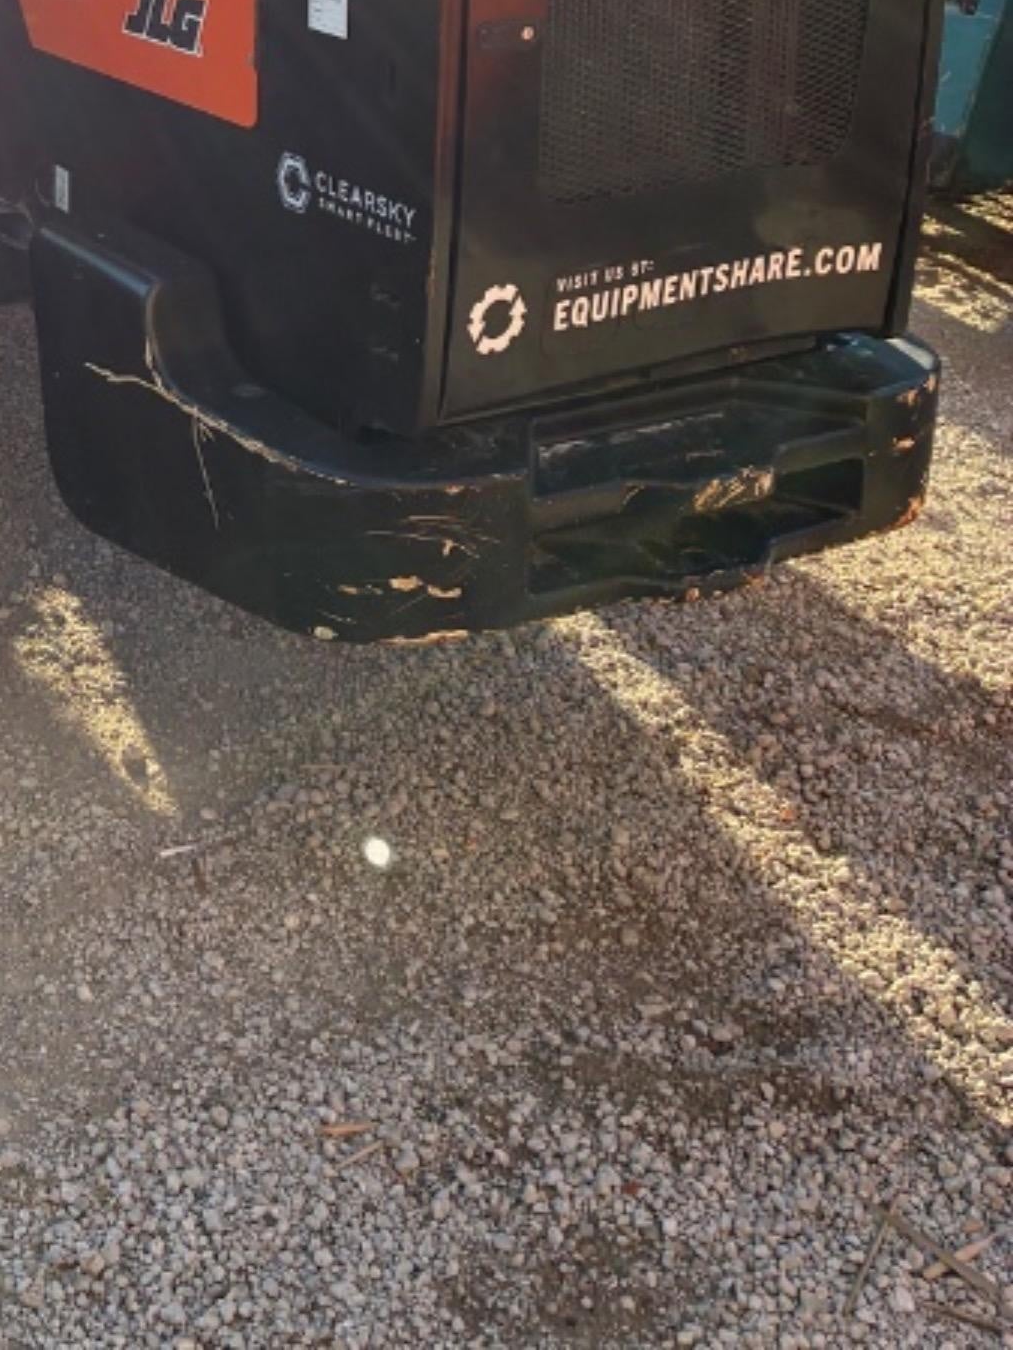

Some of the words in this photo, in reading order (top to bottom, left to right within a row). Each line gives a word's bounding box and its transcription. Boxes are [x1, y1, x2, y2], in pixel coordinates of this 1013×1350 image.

[315, 170, 417, 228] CLEARSKY
[553, 242, 883, 332] EQUIPMENTSHARE.COM
[556, 269, 599, 292] VISIT
[604, 265, 624, 283] US
